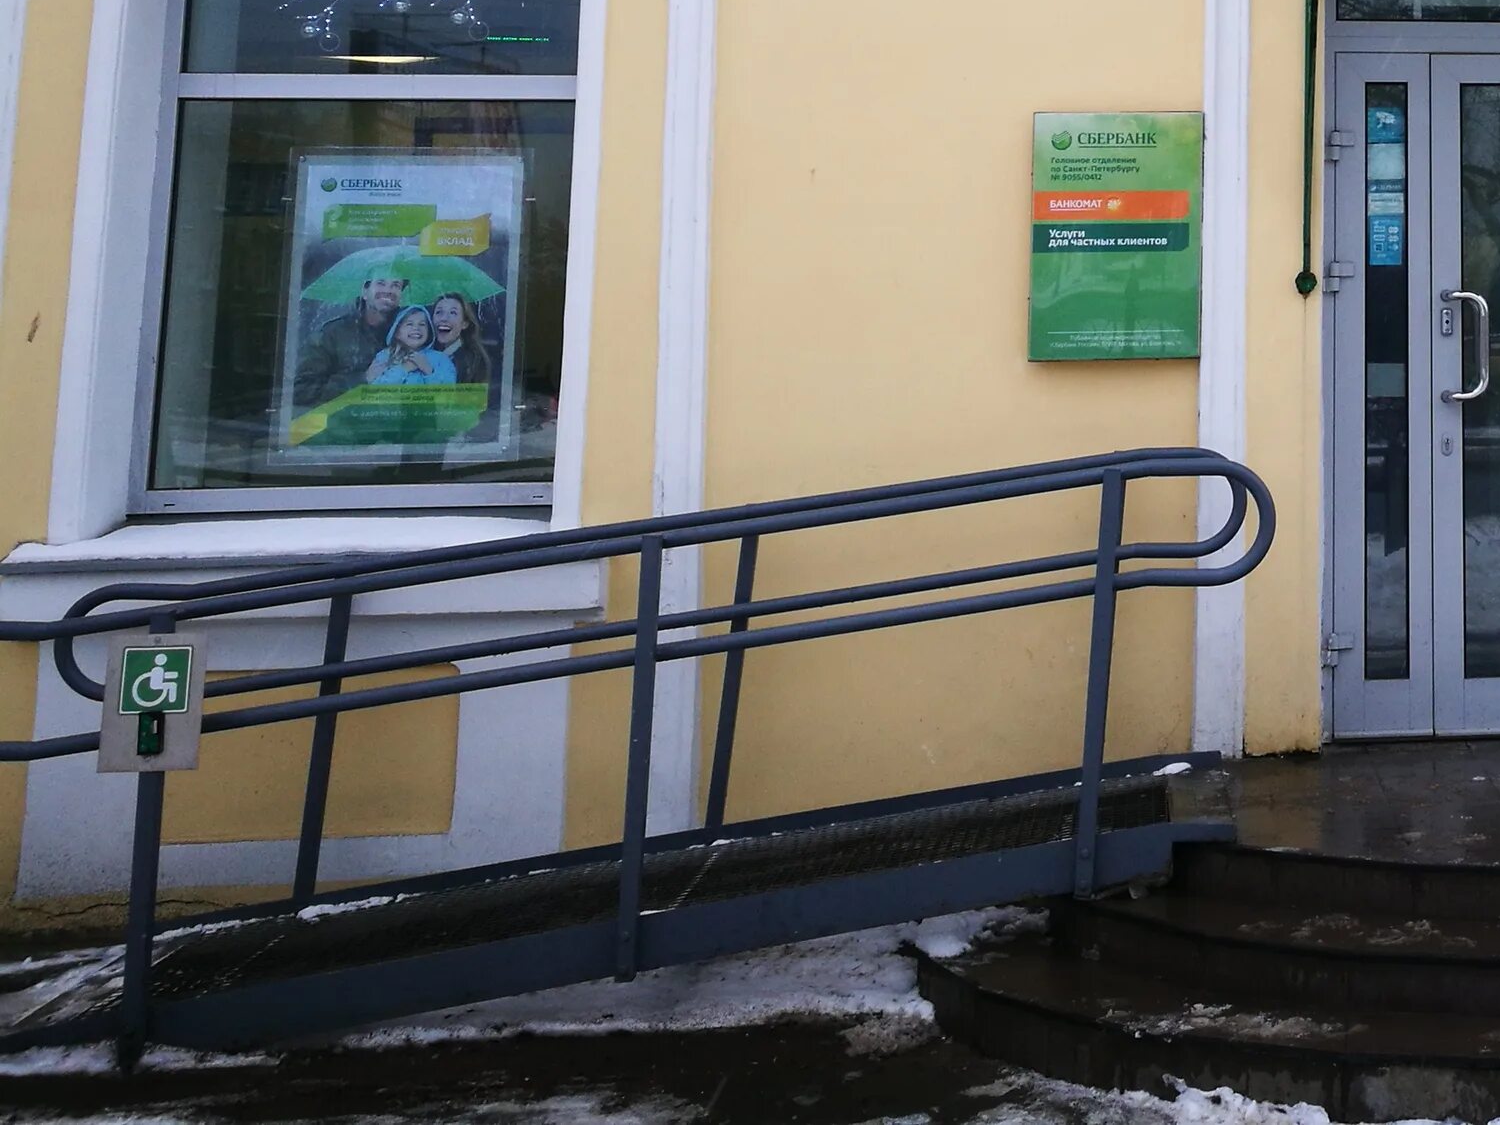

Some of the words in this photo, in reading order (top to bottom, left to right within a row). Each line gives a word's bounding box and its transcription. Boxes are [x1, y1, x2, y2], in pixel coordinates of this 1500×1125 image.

[1078, 131, 1157, 145] СБЕРБАНК
[1063, 164, 1140, 174] Санкт-Петербургу
[341, 179, 402, 188] СБЕРБАНК
[1050, 199, 1102, 209] БАНКОМАТ
[1049, 229, 1085, 240] Услуги
[1049, 239, 1069, 247] для
[1070, 238, 1115, 246] частных
[1117, 237, 1167, 246] клиентов
